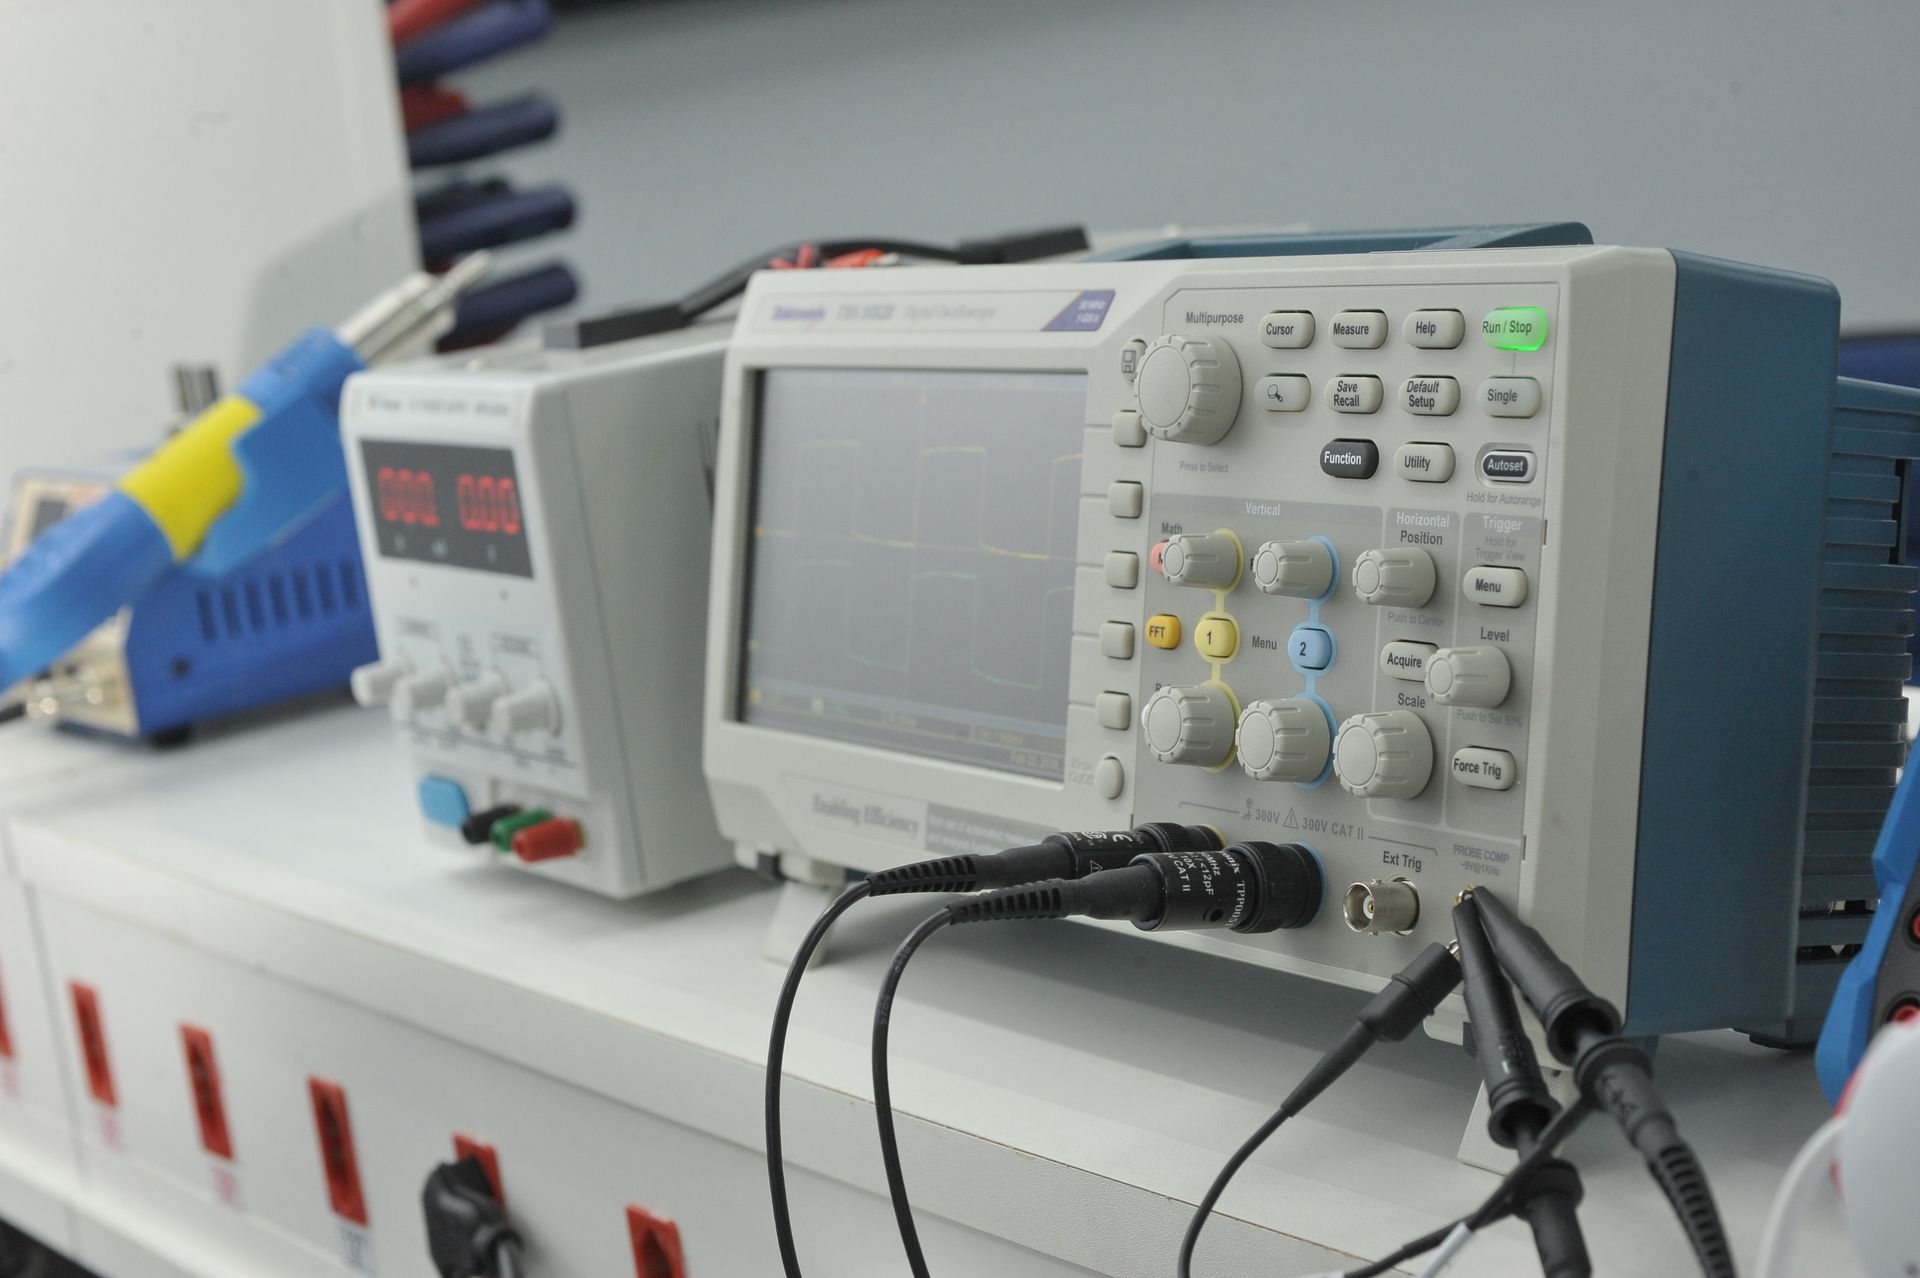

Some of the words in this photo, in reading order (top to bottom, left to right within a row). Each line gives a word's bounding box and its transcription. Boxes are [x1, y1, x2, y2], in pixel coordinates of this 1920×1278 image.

[1186, 312, 1244, 326] Multipurpose
[1266, 323, 1294, 336] Cursor
[1333, 322, 1369, 336] Measure
[1415, 321, 1436, 337] Help
[1482, 320, 1500, 334] Run
[1510, 320, 1532, 336] Stop
[1336, 381, 1358, 394] Save
[1407, 380, 1439, 394] Default
[1333, 393, 1360, 407] Recall
[1408, 395, 1435, 411] Setup
[1487, 389, 1517, 405] Single
[1179, 460, 1198, 471] Press
[1207, 462, 1229, 473] Select
[1324, 451, 1362, 466] Function
[1404, 455, 1430, 472] Utility
[1487, 458, 1524, 472] Autoset
[1466, 491, 1485, 503] Hold
[1487, 493, 1498, 504] for
[1499, 494, 1541, 508] Autorange
[1246, 503, 1281, 516] Vertical
[1396, 512, 1450, 528] Horizontal
[1482, 515, 1523, 533] Trigger
[1161, 522, 1183, 535] Math
[1400, 531, 1443, 546] Position
[1475, 578, 1502, 593] Menu
[1388, 611, 1407, 623] Push
[1409, 614, 1417, 624] to
[1418, 615, 1444, 627] Center
[1149, 625, 1165, 639] FFT
[1206, 631, 1213, 645] 1
[1480, 626, 1510, 642] Level
[1252, 635, 1278, 650] Menu
[1299, 641, 1307, 657] 2
[1386, 652, 1422, 669] Acquire
[1397, 693, 1426, 709] Scale
[1453, 758, 1479, 774] Force
[1482, 761, 1502, 780] Trig
[1255, 808, 1280, 825] 300V
[1302, 817, 1329, 835] 300V
[1331, 822, 1354, 839] CAT
[1355, 825, 1365, 841] II
[1383, 850, 1399, 865] Ext
[1401, 853, 1422, 873] Trig
[1453, 843, 1482, 860] PROBE
[1484, 849, 1511, 864] COMP
[1173, 860, 1189, 882] CAT
